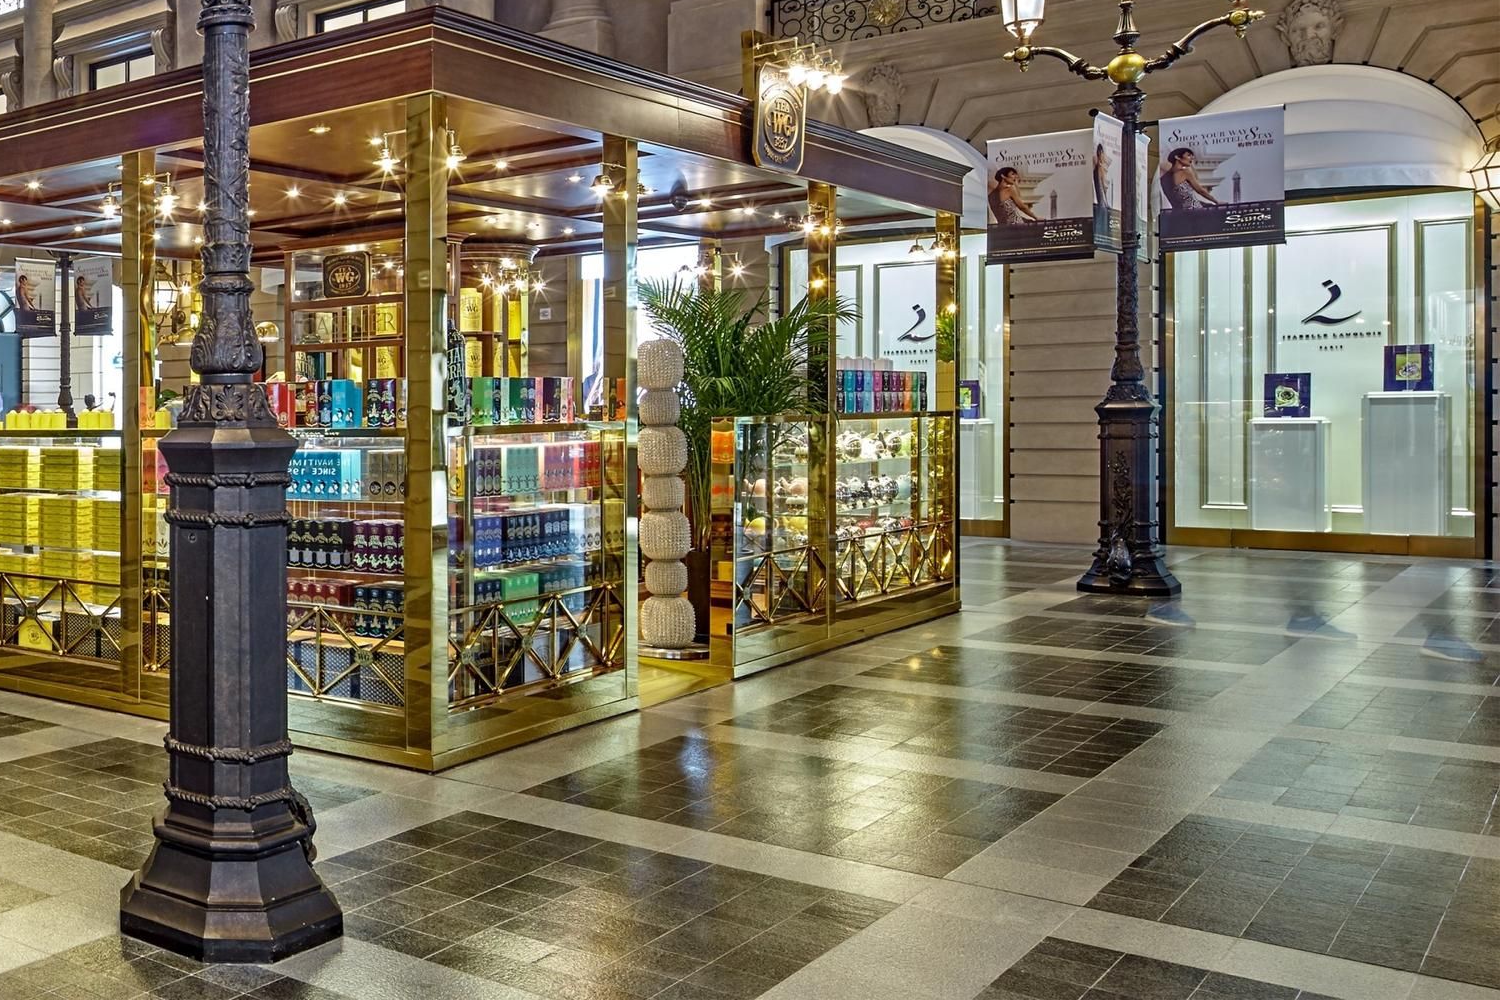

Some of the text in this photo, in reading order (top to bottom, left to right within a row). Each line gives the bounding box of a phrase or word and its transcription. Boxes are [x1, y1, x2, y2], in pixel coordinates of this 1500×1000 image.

[1168, 128, 1247, 143] SHOP YOUR WAY
[1212, 136, 1243, 145] HOTEL
[1245, 126, 1273, 141] STAY
